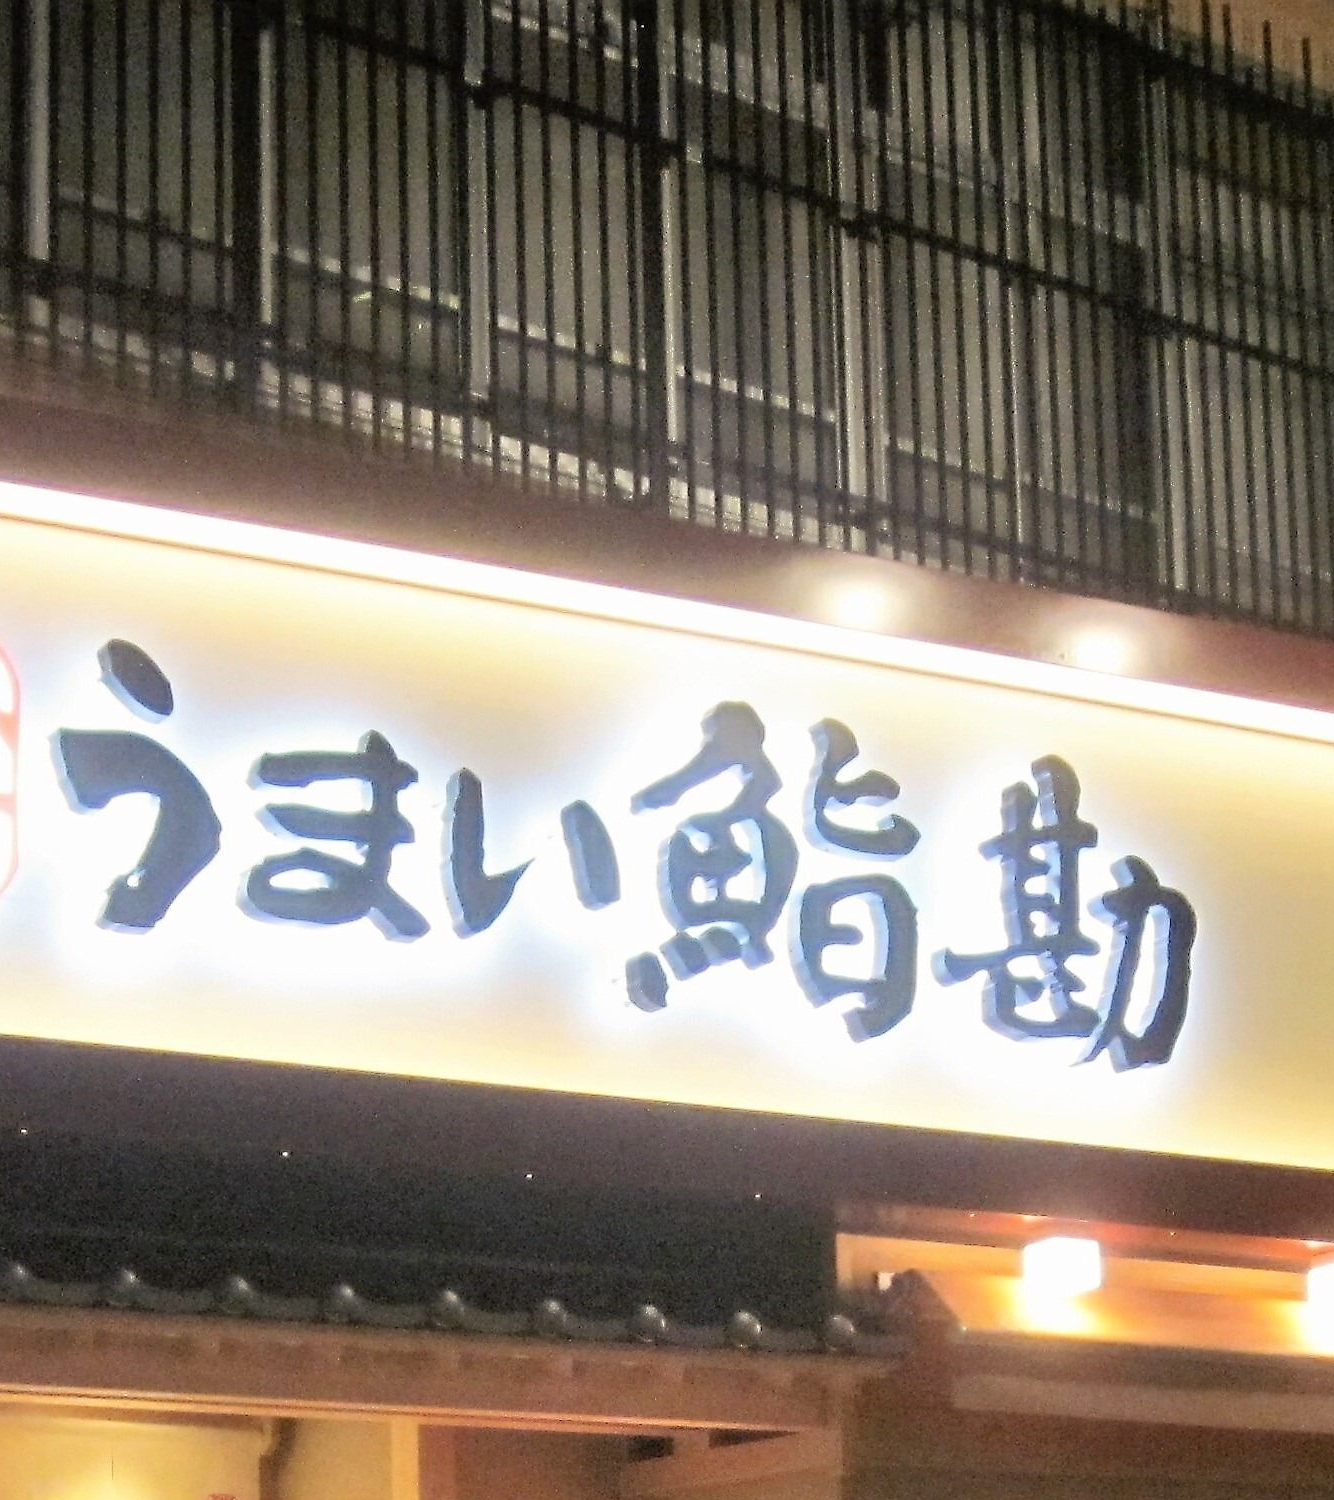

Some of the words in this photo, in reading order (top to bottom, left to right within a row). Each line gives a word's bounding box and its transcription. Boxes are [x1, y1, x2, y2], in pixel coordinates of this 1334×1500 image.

[48, 636, 1198, 1074] うまい鮨勘
